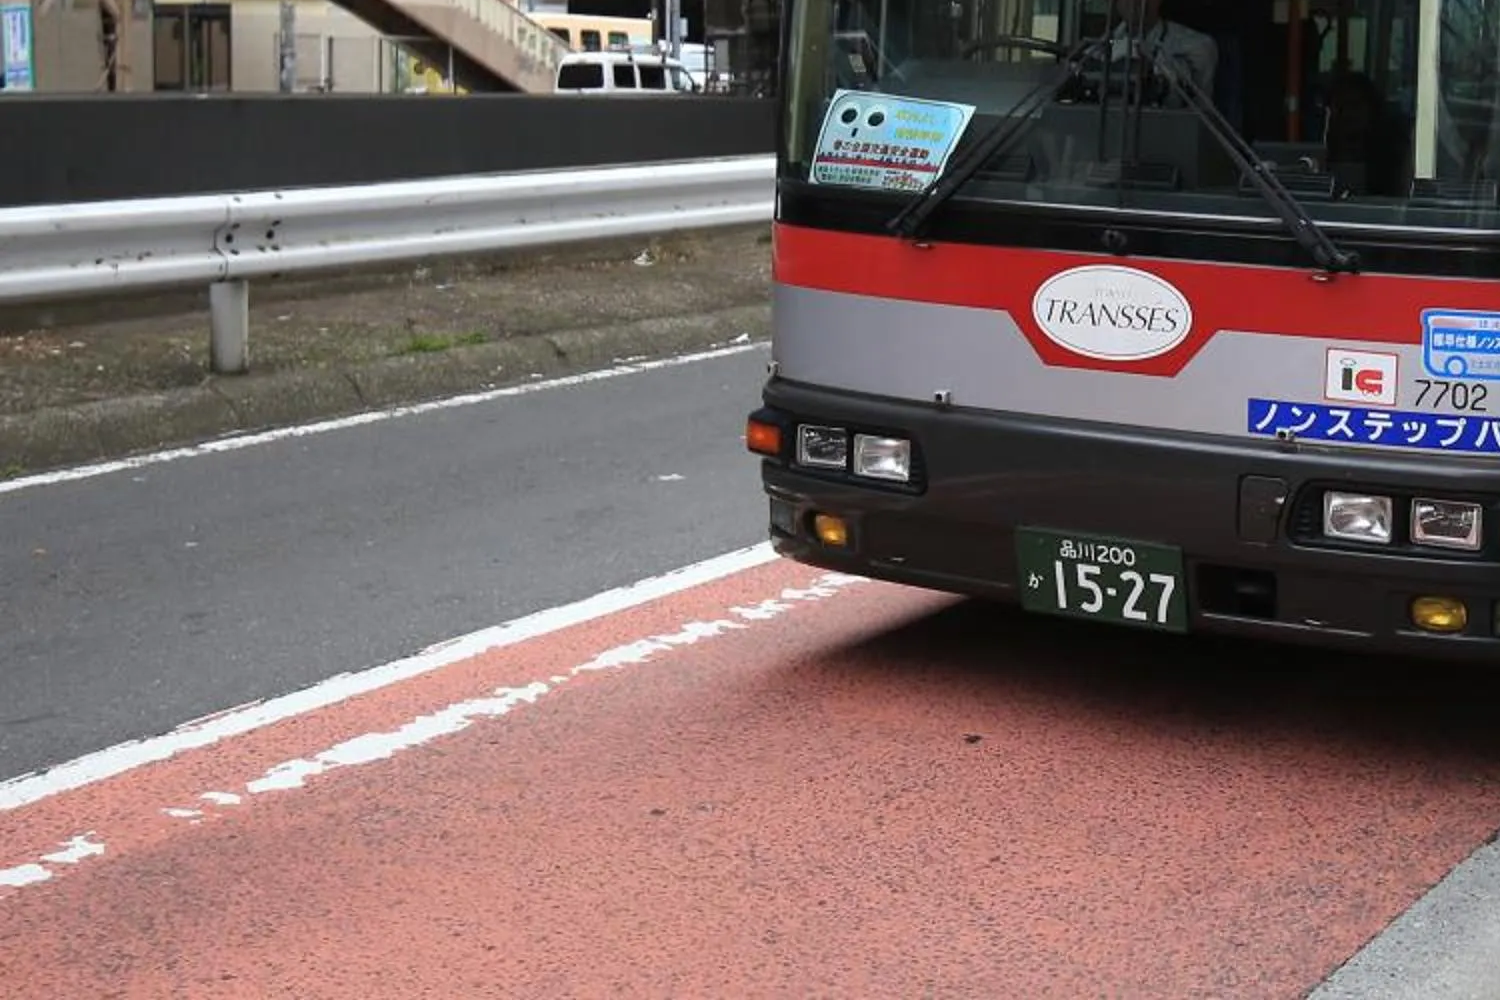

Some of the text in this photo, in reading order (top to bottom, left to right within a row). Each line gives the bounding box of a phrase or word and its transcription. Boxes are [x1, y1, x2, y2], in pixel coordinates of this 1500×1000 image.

[1415, 379, 1488, 411] 7702
[1028, 572, 1045, 588] か
[1055, 560, 1175, 623] 15-27
